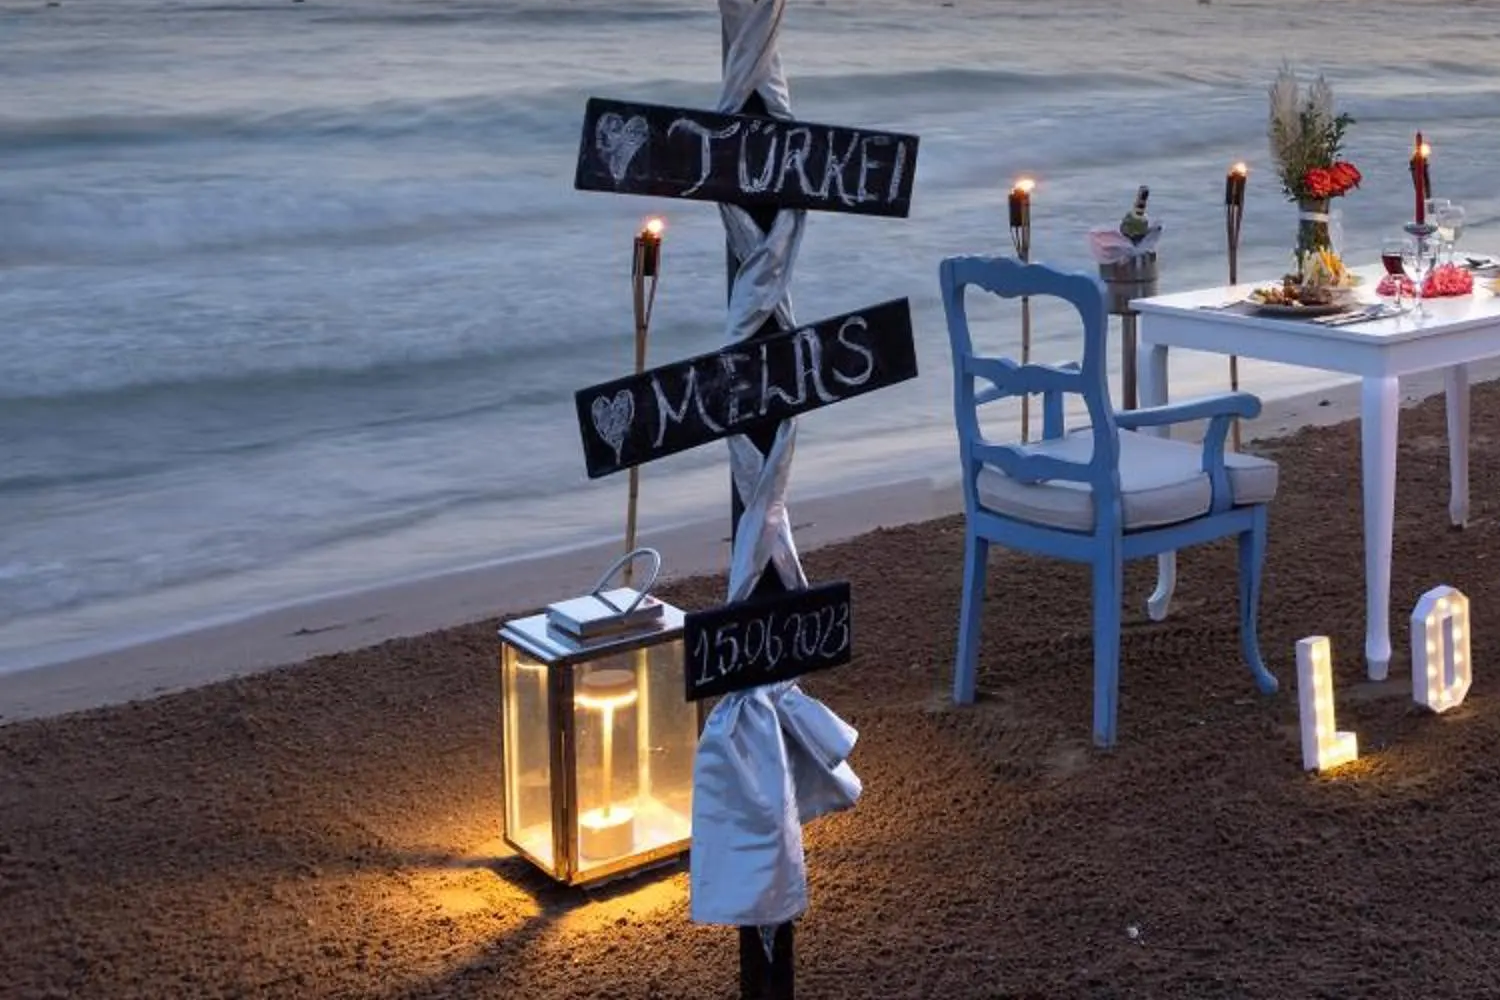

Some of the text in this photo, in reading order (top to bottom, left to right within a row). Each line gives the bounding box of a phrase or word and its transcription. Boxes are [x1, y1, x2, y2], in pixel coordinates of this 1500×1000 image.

[667, 117, 907, 206] TÜRKEI
[651, 315, 874, 448] MELAS
[694, 602, 849, 687] 15.06.2023
